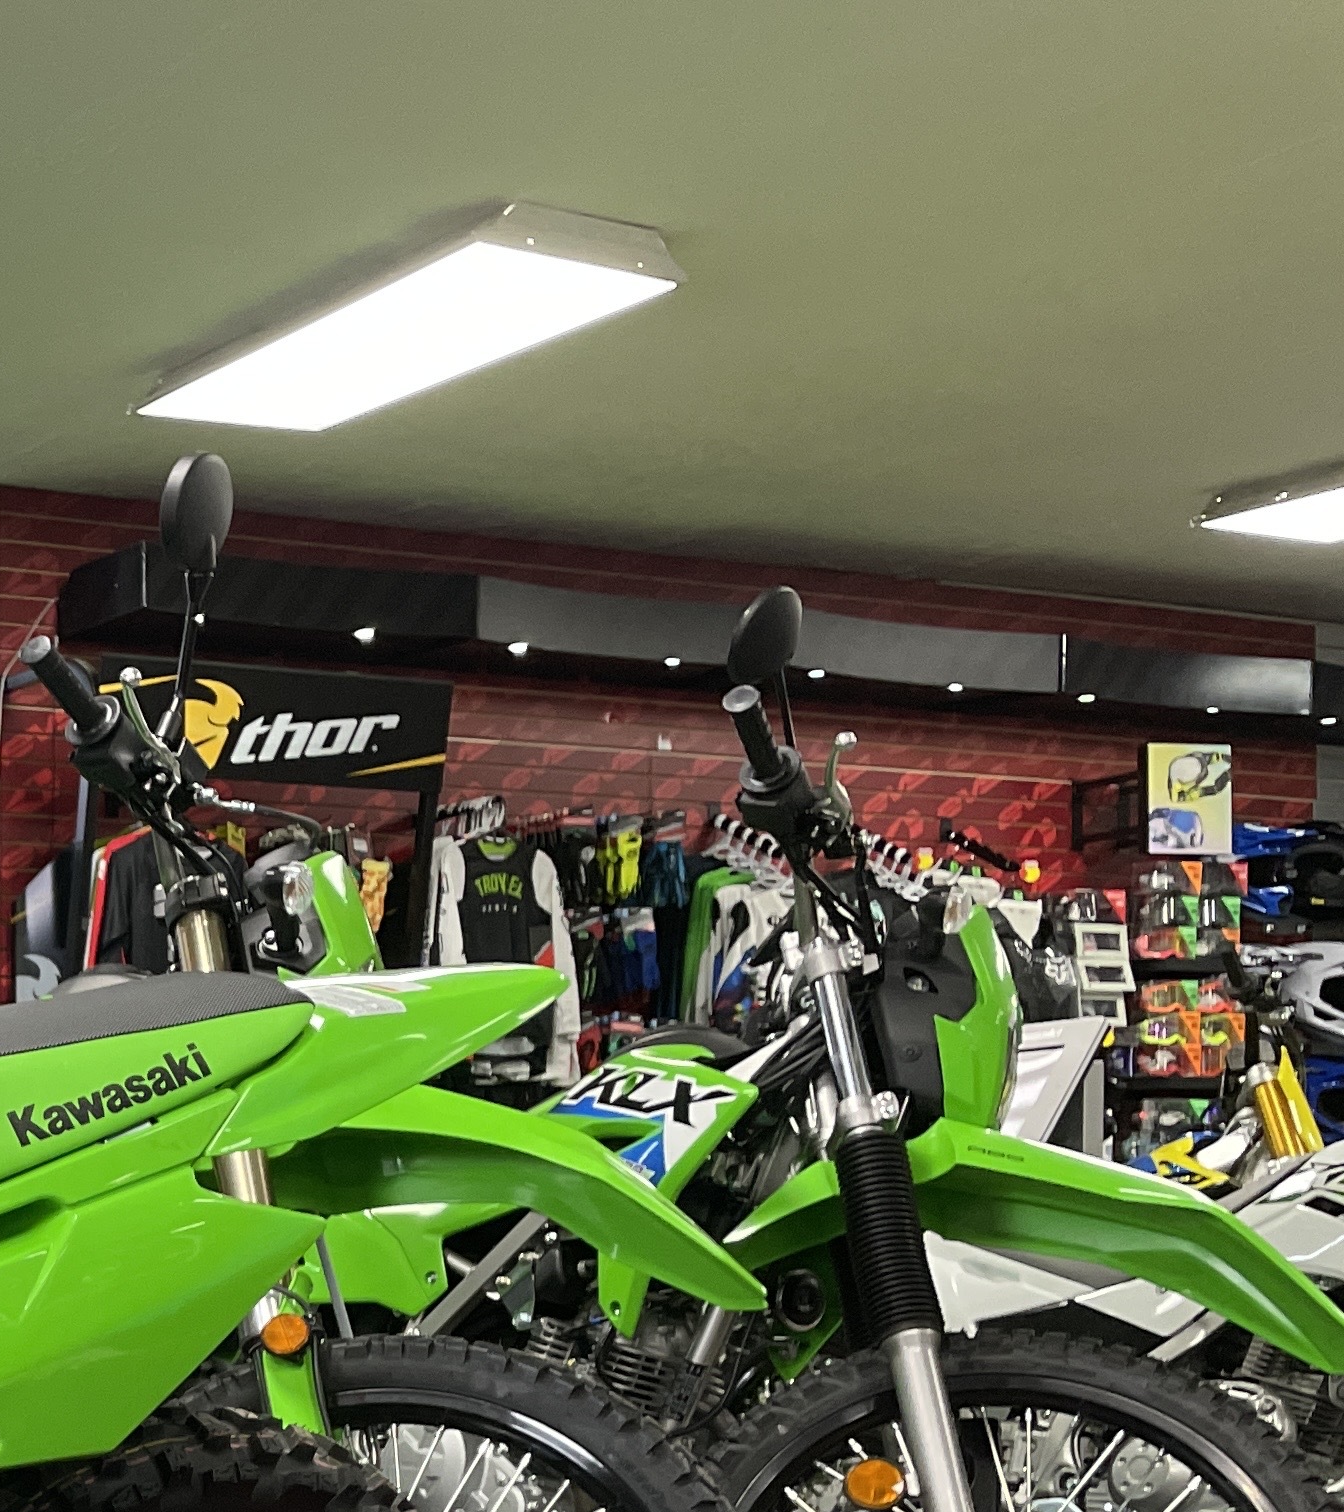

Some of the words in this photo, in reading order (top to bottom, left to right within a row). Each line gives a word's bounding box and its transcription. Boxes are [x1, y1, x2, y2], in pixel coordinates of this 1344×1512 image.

[230, 712, 400, 765] thor
[6, 1042, 212, 1147] Kawasaki
[565, 1066, 737, 1129] KLX
